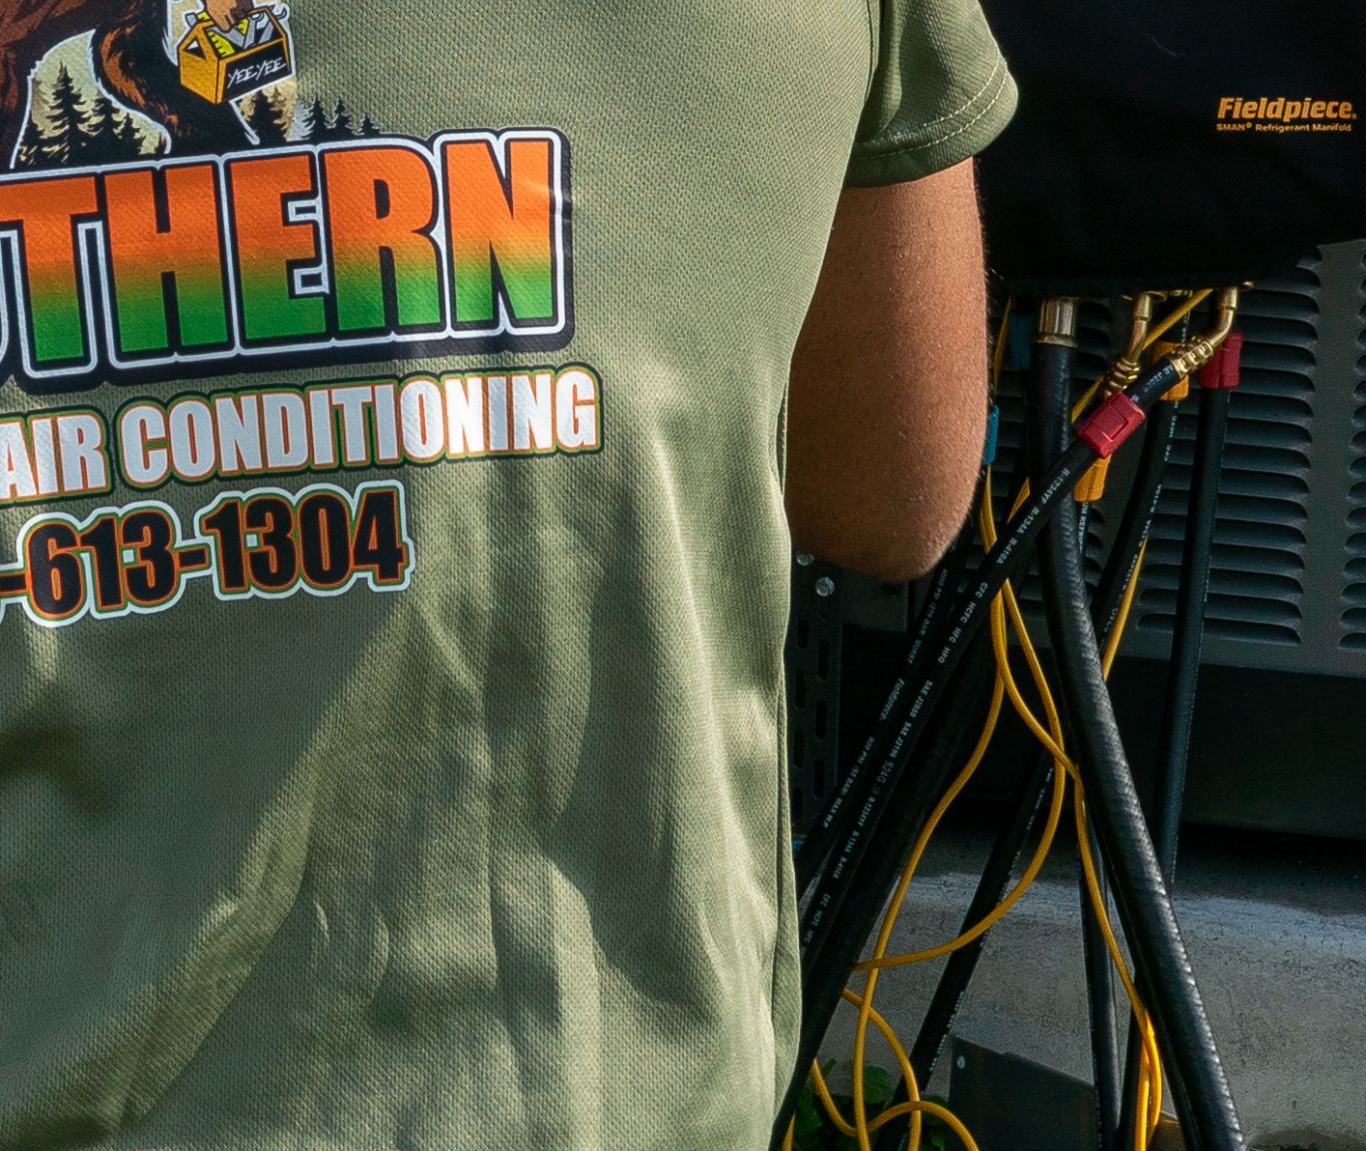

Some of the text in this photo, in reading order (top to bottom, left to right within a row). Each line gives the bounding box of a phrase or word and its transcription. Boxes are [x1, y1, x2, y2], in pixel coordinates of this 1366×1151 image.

[1217, 97, 1352, 122] Fieldpiece
[1255, 123, 1309, 133] Refrigerant
[1312, 123, 1352, 132] Manifold
[119, 370, 598, 484] CONDITIONING
[1041, 468, 1070, 504] R-1234YF
[1017, 506, 1040, 534] R-134A
[996, 537, 1018, 564] R-410A
[975, 582, 988, 598] CFC
[960, 601, 976, 623] HCFC
[949, 627, 962, 643] HFC
[937, 646, 951, 663] HFO
[920, 679, 933, 696] SAE
[900, 721, 912, 736] SAE
